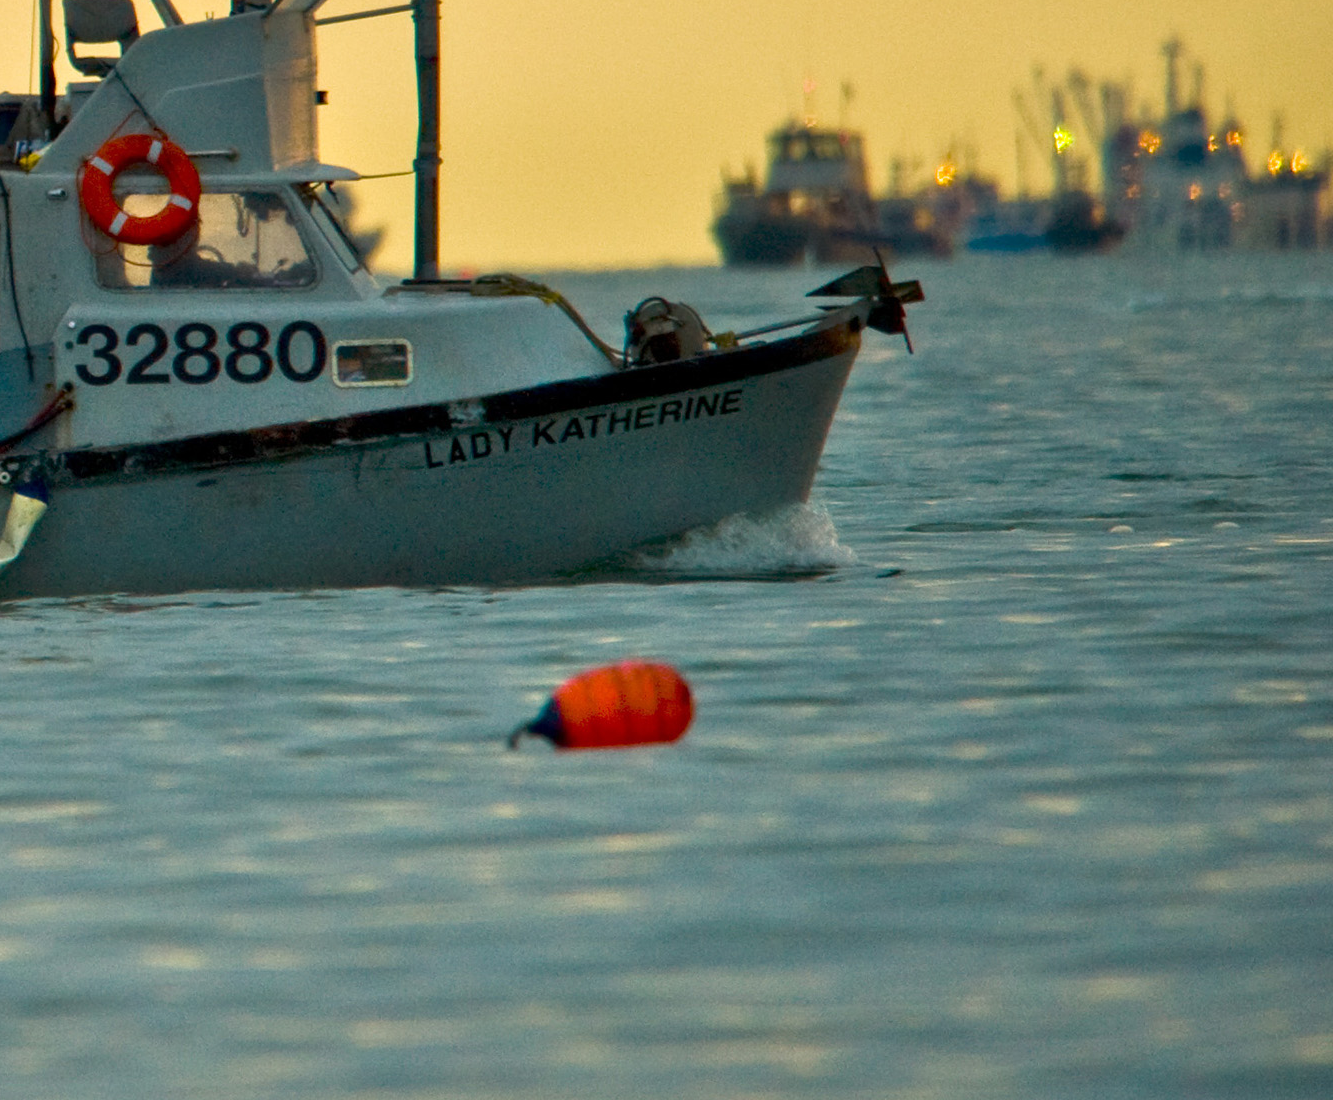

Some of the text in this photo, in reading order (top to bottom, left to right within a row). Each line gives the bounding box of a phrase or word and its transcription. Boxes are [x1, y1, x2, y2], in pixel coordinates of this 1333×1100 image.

[75, 320, 327, 386] 32880
[424, 389, 743, 469] LADY KATHERINE
